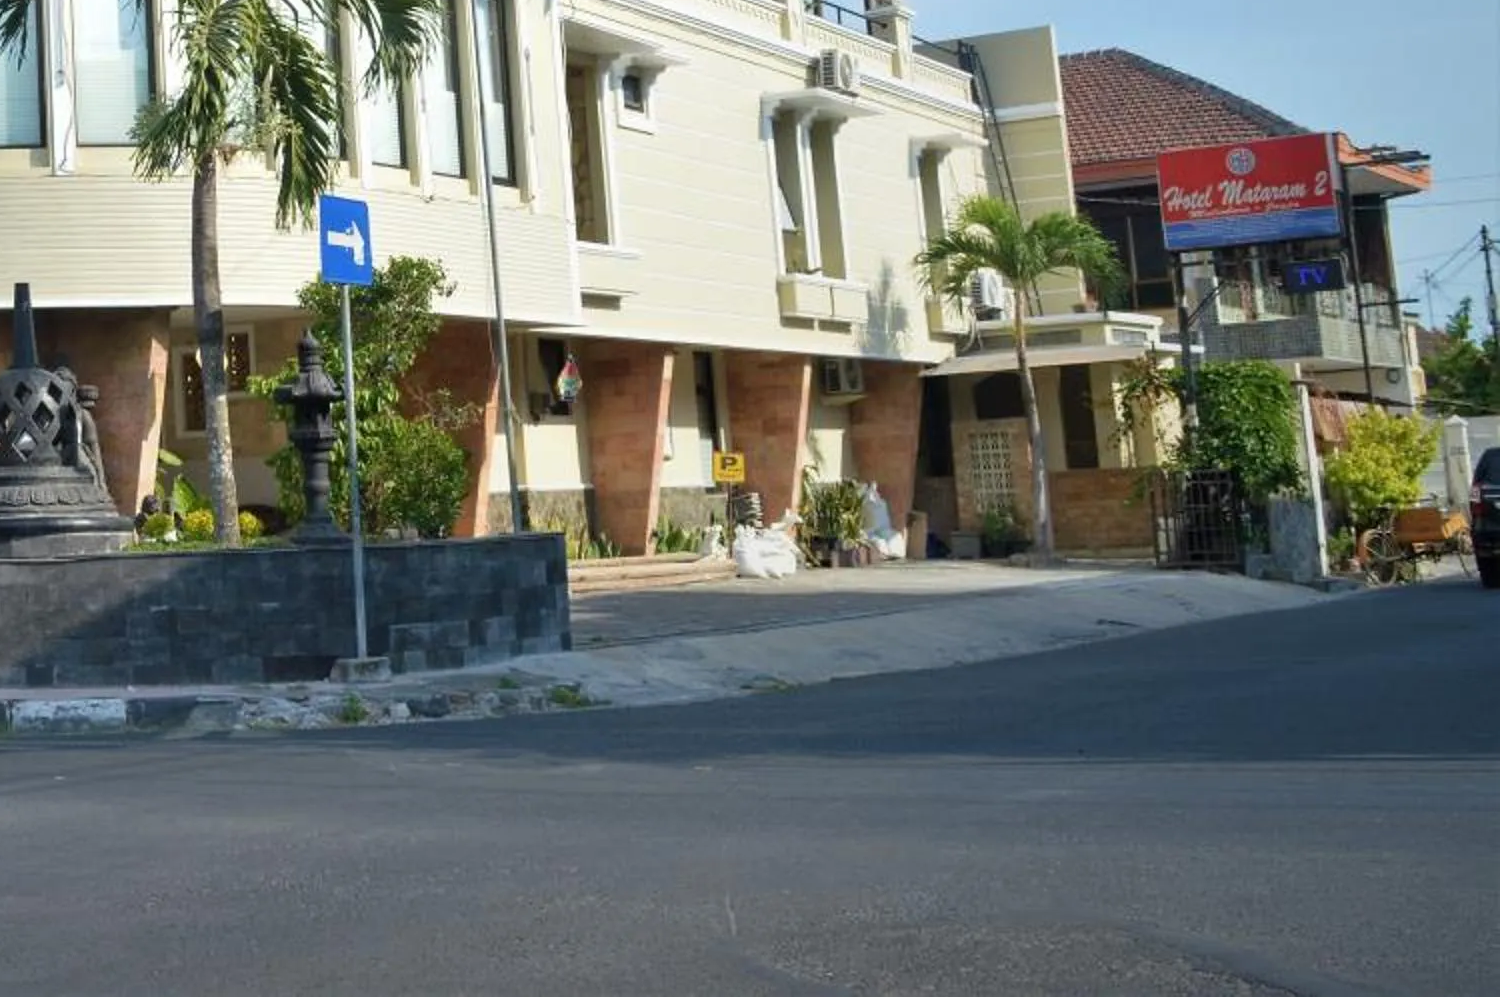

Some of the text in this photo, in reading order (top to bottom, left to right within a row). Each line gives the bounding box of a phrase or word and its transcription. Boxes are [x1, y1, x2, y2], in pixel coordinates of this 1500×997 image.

[1164, 184, 1212, 212] Hotel
[1219, 179, 1307, 205] Mataram
[1313, 170, 1328, 196] 2
[1299, 267, 1328, 285] TV
[721, 456, 738, 470] P
